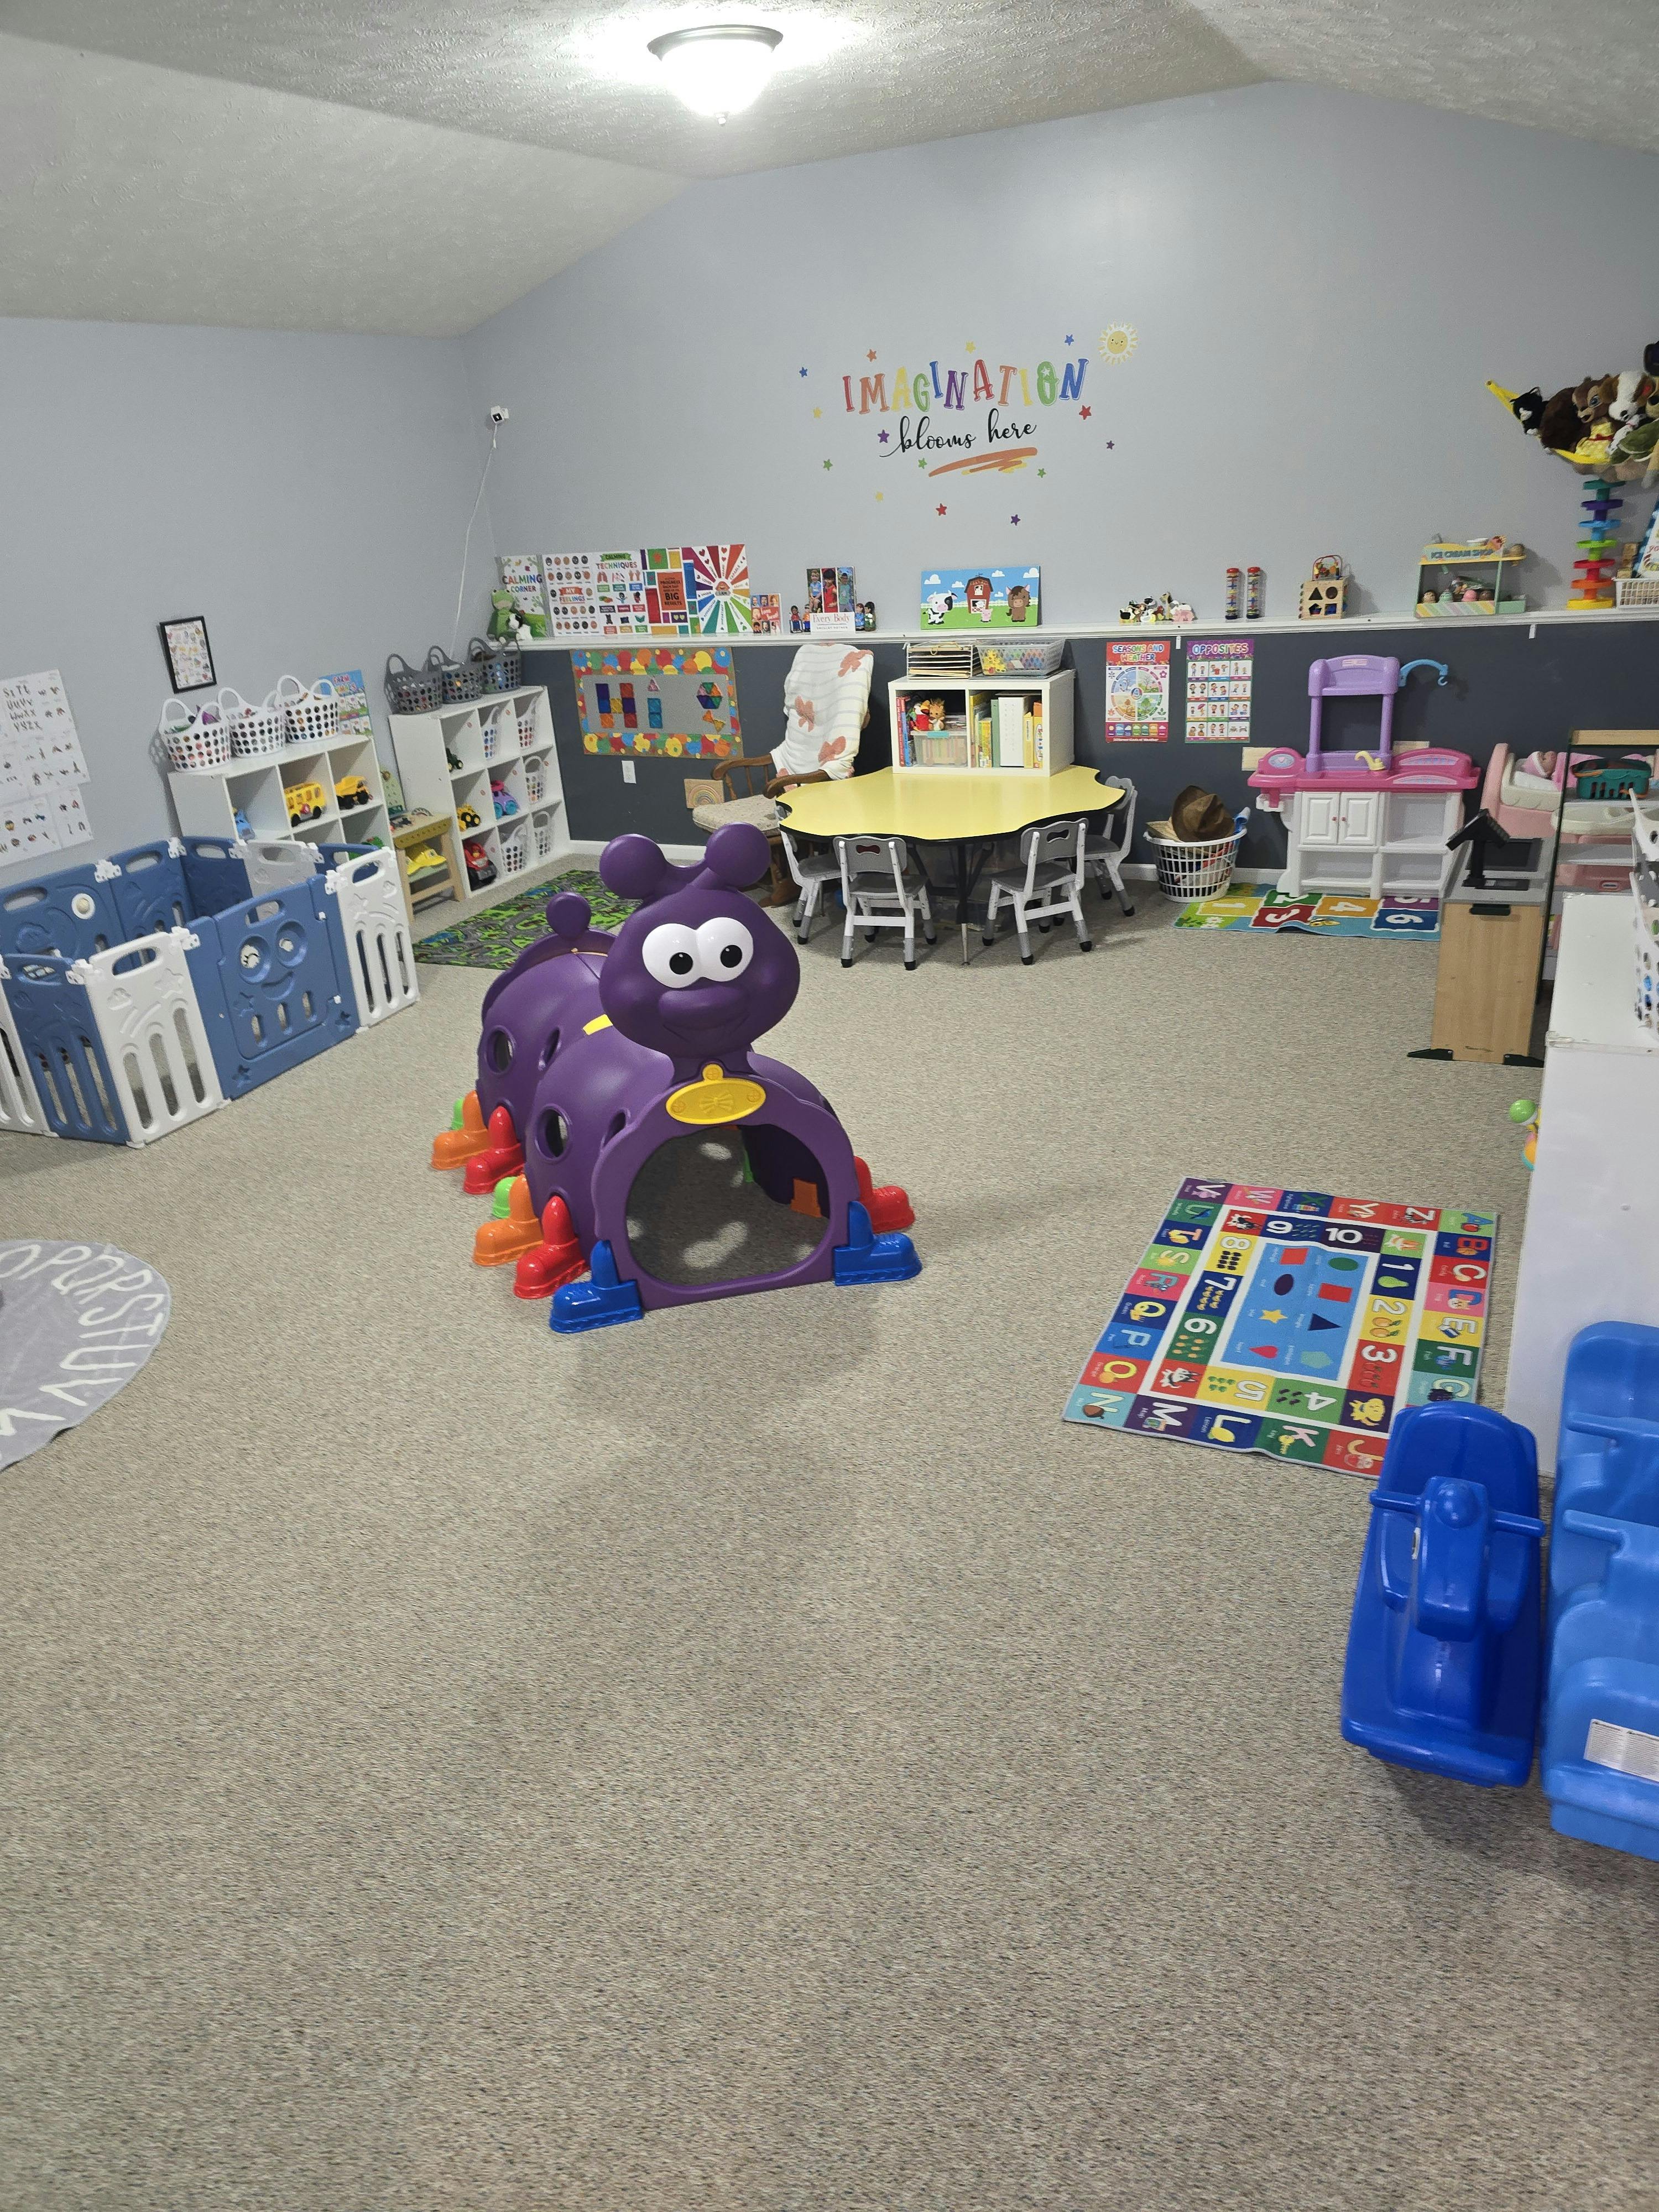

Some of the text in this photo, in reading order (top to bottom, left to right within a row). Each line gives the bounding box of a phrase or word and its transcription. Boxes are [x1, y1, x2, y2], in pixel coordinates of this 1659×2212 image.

[842, 358, 1089, 414] IMAGINATION
[879, 408, 1037, 458] blooms here
[596, 561, 638, 570] TECHNIQUES
[502, 573, 543, 585] CALMING
[510, 585, 537, 593] CORNER
[813, 613, 850, 623] Every Body
[1113, 644, 1164, 653] SEASONS AND
[1192, 643, 1249, 655] OPPOSITES
[1120, 653, 1155, 662] WEATHER
[1329, 901, 1367, 912] 4
[1265, 909, 1301, 923] 3
[1385, 914, 1424, 924] 6
[1196, 1184, 1226, 1196] V
[1245, 1190, 1276, 1204] W
[1301, 1194, 1328, 1207] X
[1349, 1202, 1380, 1219] Y
[1406, 1207, 1436, 1222] Z
[1462, 1212, 1494, 1226] A
[1171, 1228, 1203, 1241] T
[1266, 1220, 1293, 1234] 9
[1220, 1236, 1253, 1250] 8
[1325, 1228, 1363, 1244] 10
[1458, 1237, 1489, 1251] B
[1160, 1250, 1190, 1264] S
[1382, 1262, 1415, 1271] 1
[1453, 1264, 1487, 1279] C
[1145, 1272, 1179, 1288] R
[1204, 1277, 1237, 1291] 7
[1448, 1289, 1483, 1306] D
[1133, 1301, 1166, 1318] Q
[1373, 1298, 1407, 1315] 2
[1184, 1318, 1217, 1335] 6
[1443, 1317, 1479, 1333] E
[1120, 1329, 1152, 1346] P
[1361, 1345, 1398, 1363] 3
[1437, 1346, 1473, 1366] F
[1104, 1360, 1137, 1379] O
[1235, 1380, 1267, 1402] 5
[1433, 1378, 1472, 1398] G
[1089, 1392, 1125, 1413] N
[1304, 1392, 1338, 1411] 4
[1152, 1402, 1188, 1426] M
[1211, 1415, 1252, 1431] L
[1282, 1425, 1319, 1447] K
[1347, 1439, 1385, 1461] J
